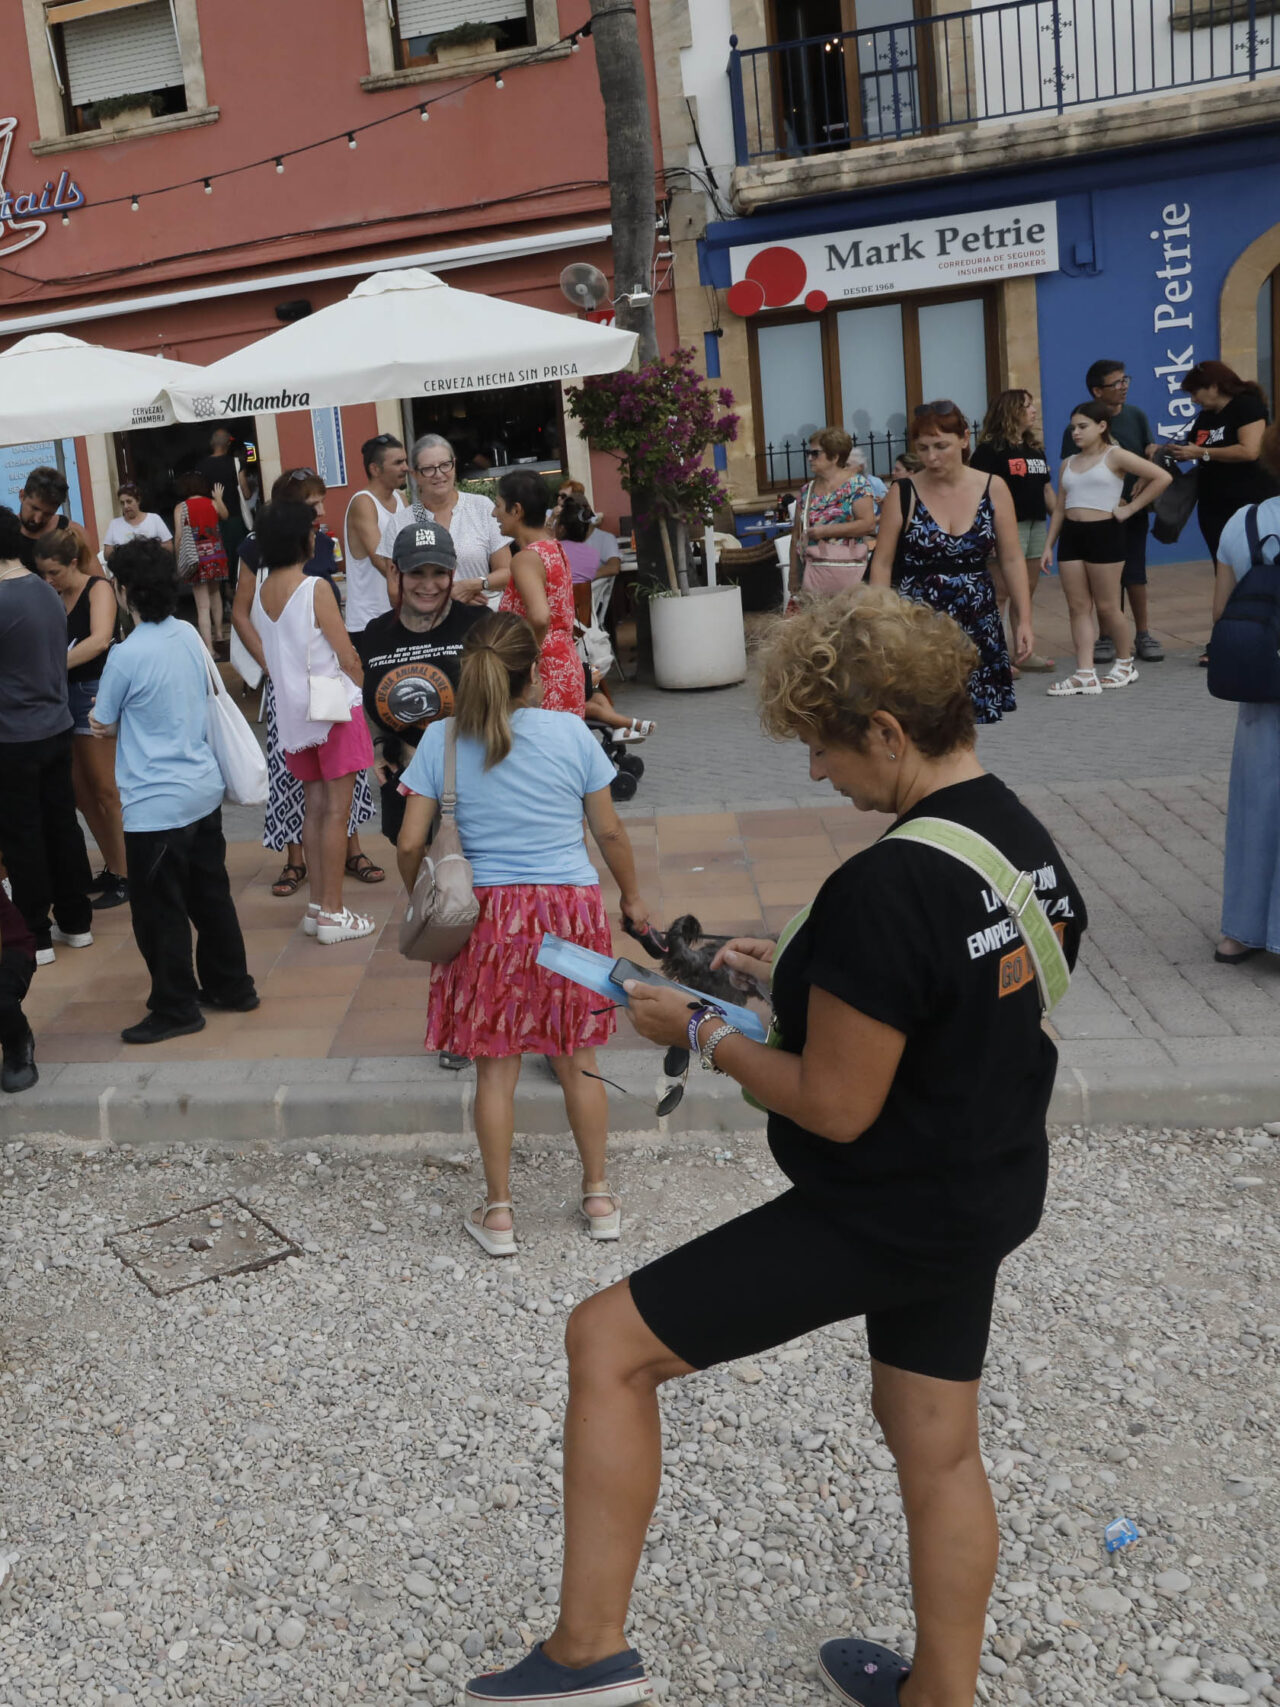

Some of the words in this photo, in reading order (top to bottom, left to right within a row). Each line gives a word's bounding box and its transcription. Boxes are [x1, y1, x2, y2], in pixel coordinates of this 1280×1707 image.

[824, 232, 925, 272] Mark
[935, 218, 1045, 257] Petrie
[938, 255, 991, 270] CORREDURIA
[994, 254, 1004, 262] DE
[1007, 249, 1046, 260] SEGUROS
[958, 264, 1005, 276] INSURANCE
[1008, 259, 1046, 270] BROKERS
[1150, 202, 1193, 333] Petrie
[843, 285, 874, 296] DESDE
[875, 282, 894, 292] 1968
[424, 376, 474, 392] CERVEZA
[477, 371, 515, 386] HECHA
[518, 368, 538, 382] SIN
[544, 363, 578, 378] PRISA
[132, 405, 163, 416] CERVEZAS
[220, 389, 310, 415] Alhambra
[131, 414, 165, 425] ALHAMBRA
[408, 643, 432, 651] VEGANA
[966, 917, 1019, 960] EMPIEZ
[1001, 956, 1023, 989] GO
